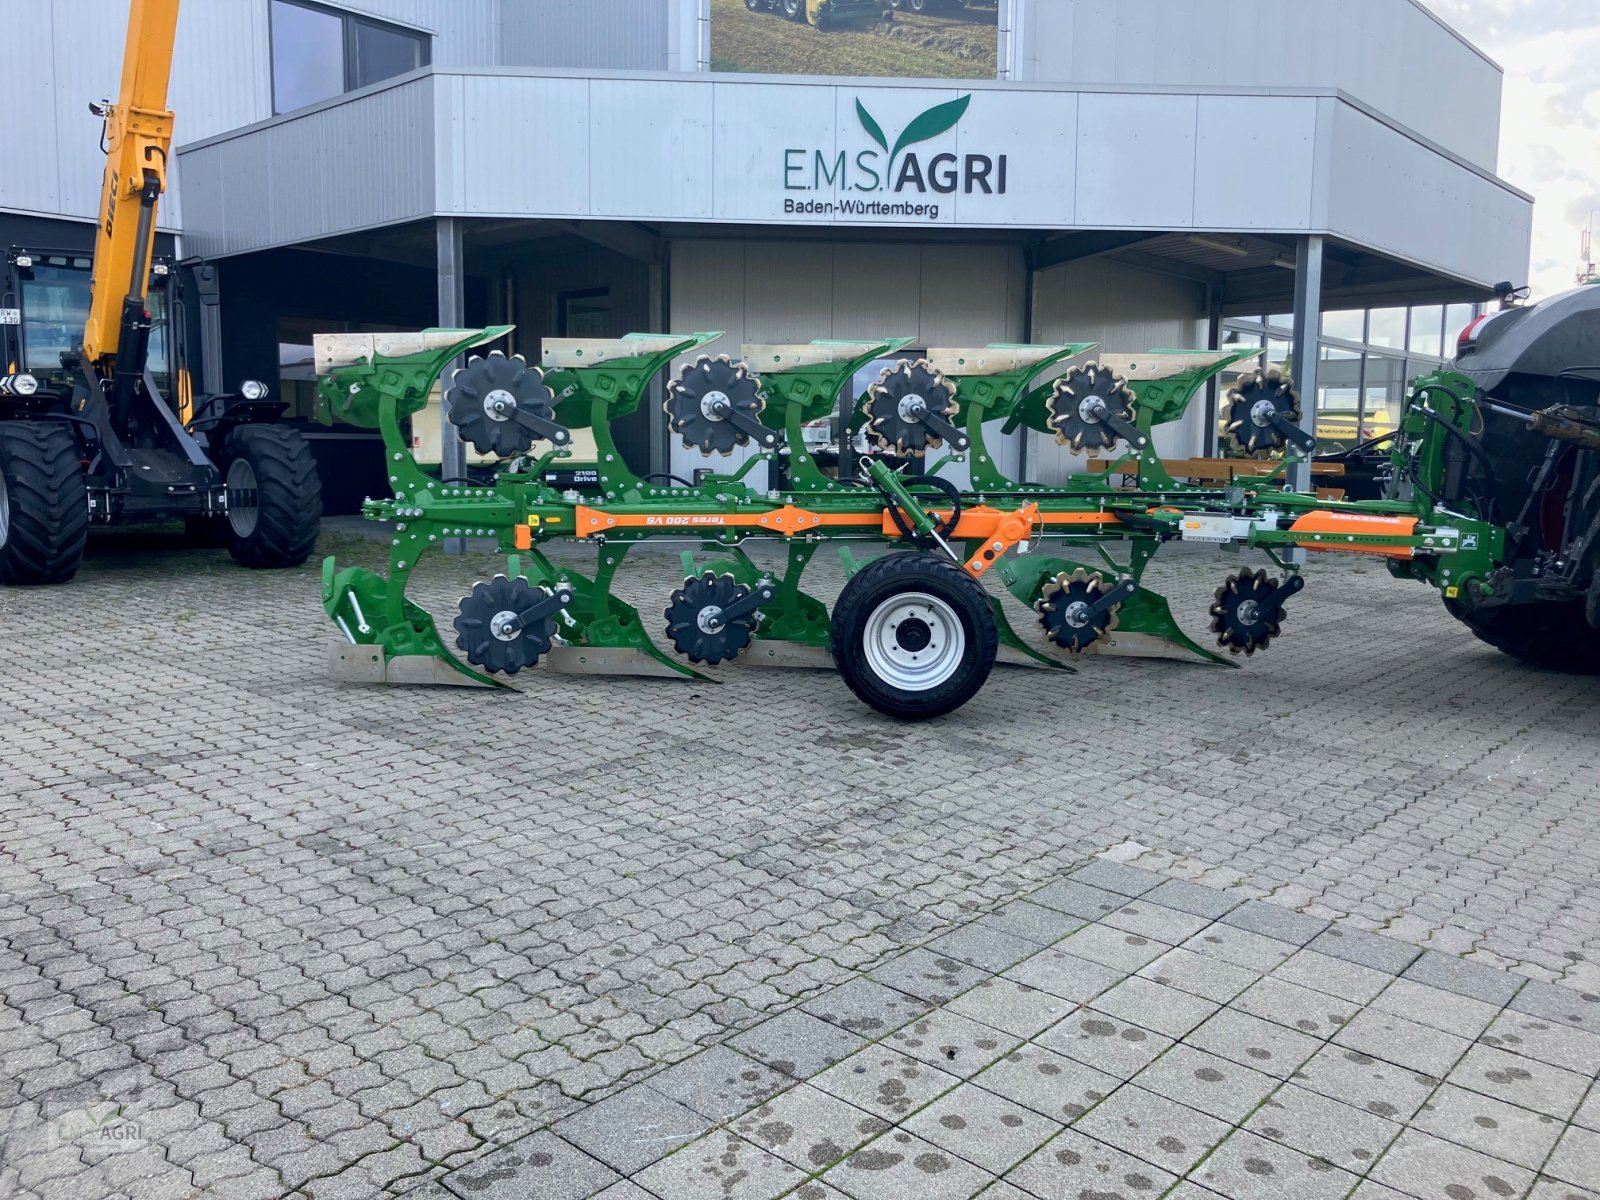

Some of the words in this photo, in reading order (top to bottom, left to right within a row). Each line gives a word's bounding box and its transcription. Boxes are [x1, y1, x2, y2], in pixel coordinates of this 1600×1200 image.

[784, 148, 884, 192] E.M.S.
[894, 152, 1007, 194] AGRI
[106, 169, 119, 239] DIECI
[784, 198, 939, 218] Baden-Württemberg
[646, 516, 663, 525] VS
[665, 516, 690, 525] 200
[692, 516, 725, 524] Teres
